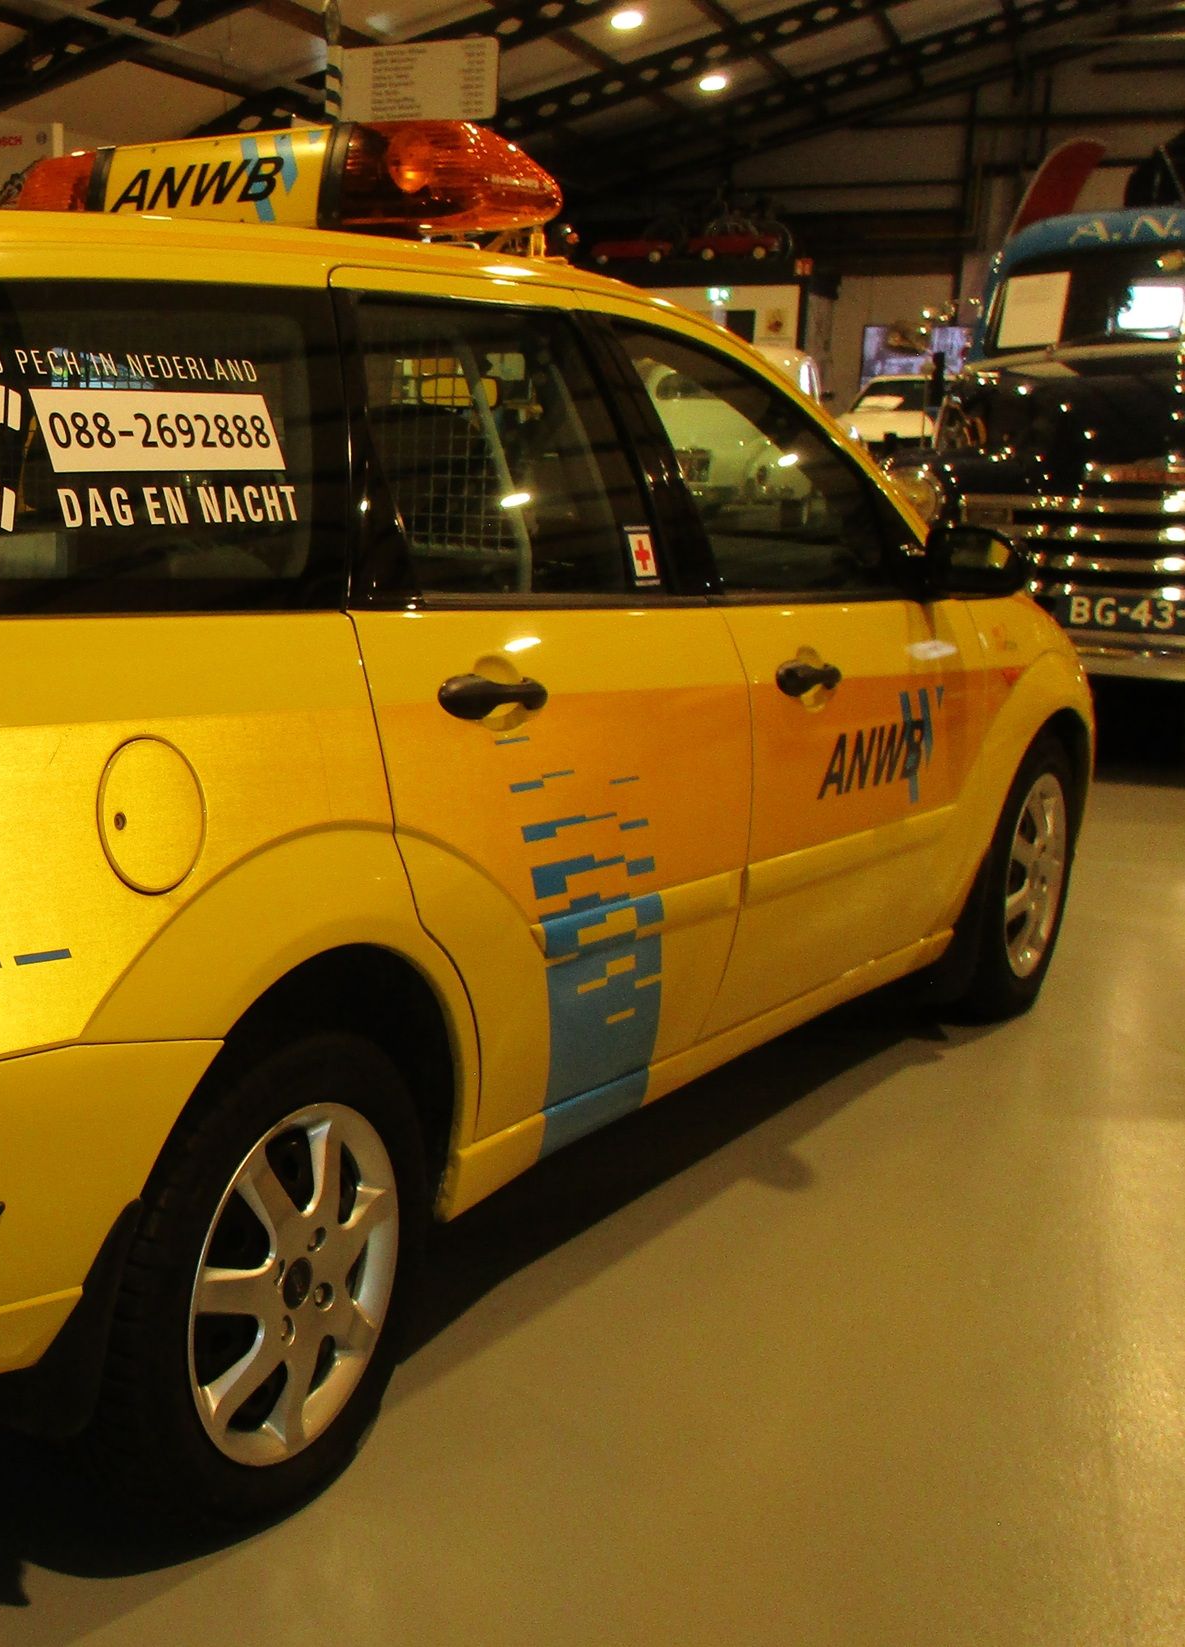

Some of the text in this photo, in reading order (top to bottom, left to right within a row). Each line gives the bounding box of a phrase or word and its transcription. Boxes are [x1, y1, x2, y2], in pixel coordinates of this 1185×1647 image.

[110, 156, 285, 213] ANWB
[15, 349, 82, 377] PECH
[89, 353, 118, 377] IN
[126, 354, 258, 383] NEDERLAND
[48, 412, 271, 449] 088-2692888
[57, 485, 298, 528] DAG EN NACHT
[817, 720, 925, 800] ANWB
